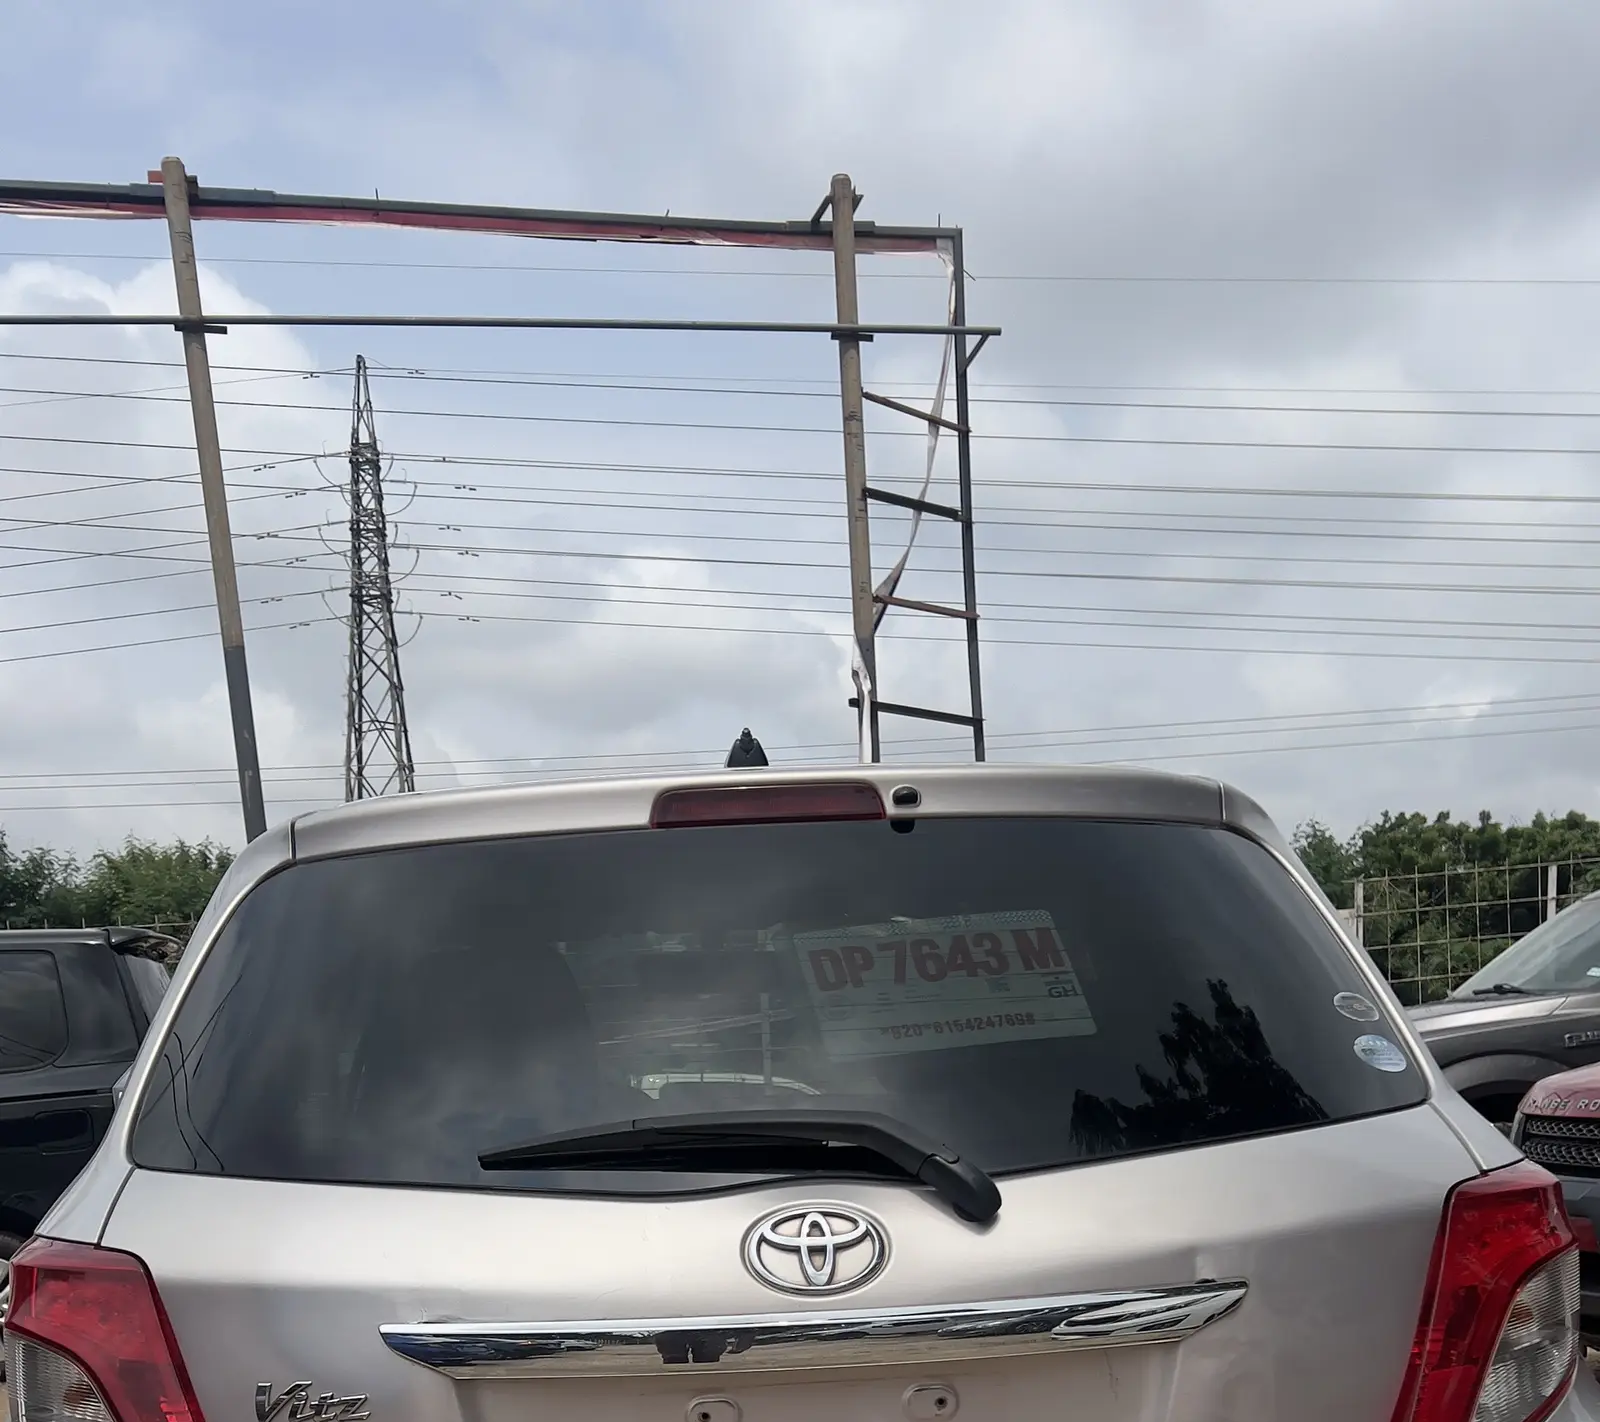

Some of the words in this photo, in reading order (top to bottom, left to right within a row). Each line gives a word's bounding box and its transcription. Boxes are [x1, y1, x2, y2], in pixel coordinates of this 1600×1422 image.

[808, 946, 875, 992] DP
[877, 931, 1010, 986] 7643
[1011, 926, 1066, 971] M
[1525, 1096, 1573, 1112] RANGE
